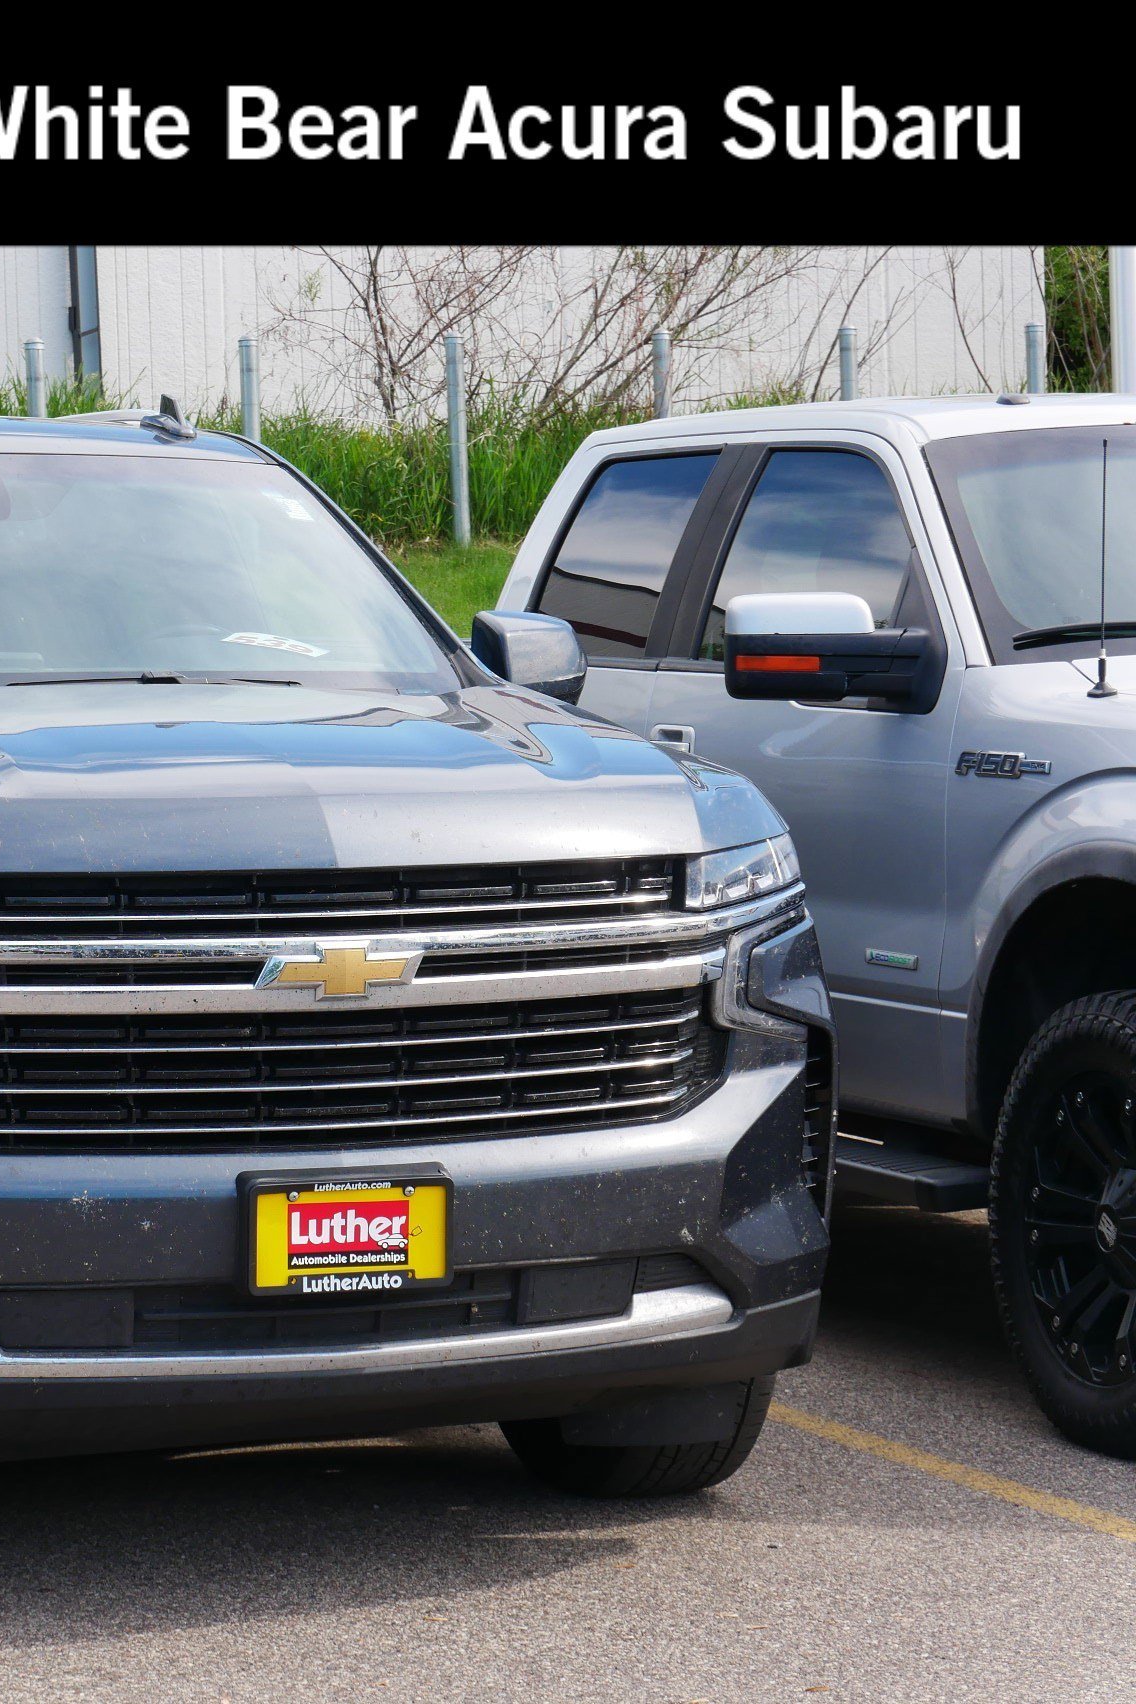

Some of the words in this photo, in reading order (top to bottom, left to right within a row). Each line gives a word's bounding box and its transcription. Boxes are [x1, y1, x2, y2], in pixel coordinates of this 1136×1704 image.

[314, 1181, 391, 1192] LutherAuto.com
[291, 1209, 407, 1245] Luther
[291, 1253, 347, 1266] Automobile
[349, 1252, 405, 1264] Dealerships
[302, 1272, 402, 1293] LutherAuto
